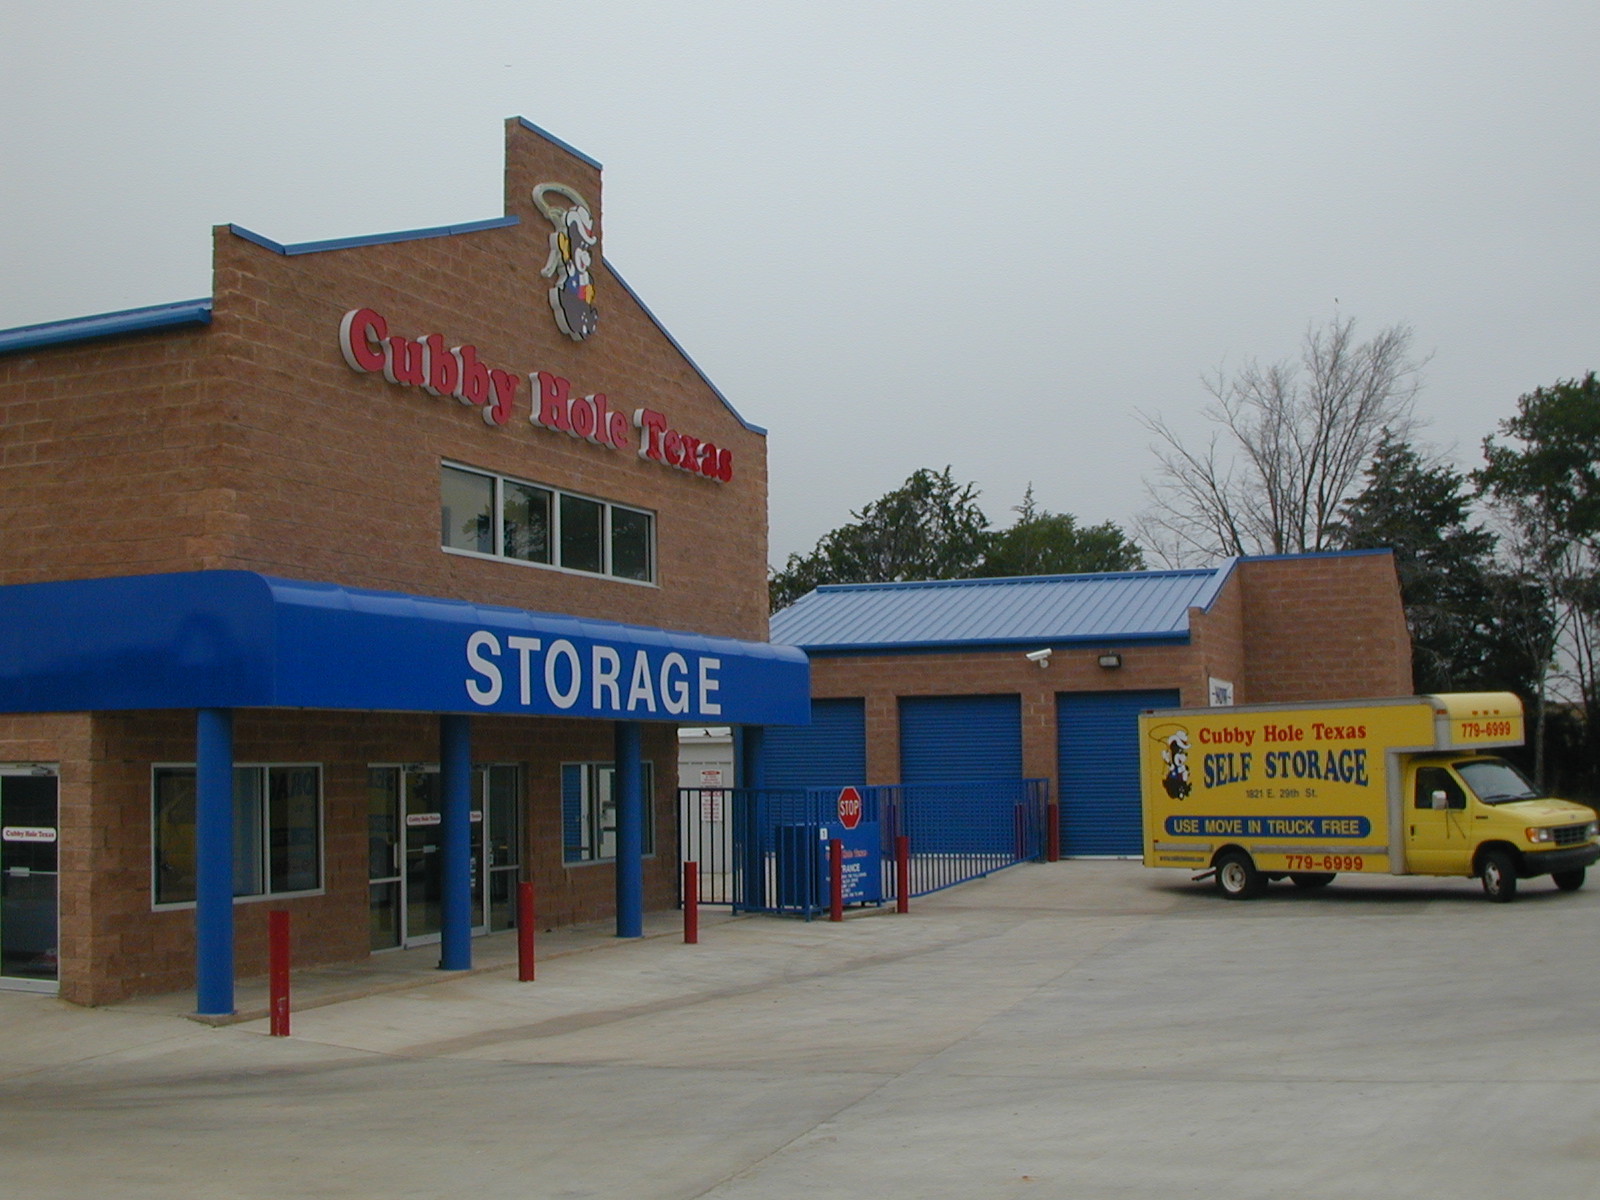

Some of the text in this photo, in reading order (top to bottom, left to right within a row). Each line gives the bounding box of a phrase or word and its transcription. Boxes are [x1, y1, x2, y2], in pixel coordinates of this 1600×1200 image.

[339, 308, 732, 483] Cubby Hole Texas
[465, 630, 721, 716] STORAGE
[1199, 723, 1367, 746] Cubby Hole Texas
[1462, 721, 1511, 738] 779-6999
[1204, 749, 1369, 788] SELF STORAGE
[1279, 788, 1300, 798] 29th
[840, 801, 859, 816] STOP
[1174, 819, 1360, 834] USE MOVE IN TRUCK FREE
[1286, 855, 1363, 870] 779-6999
